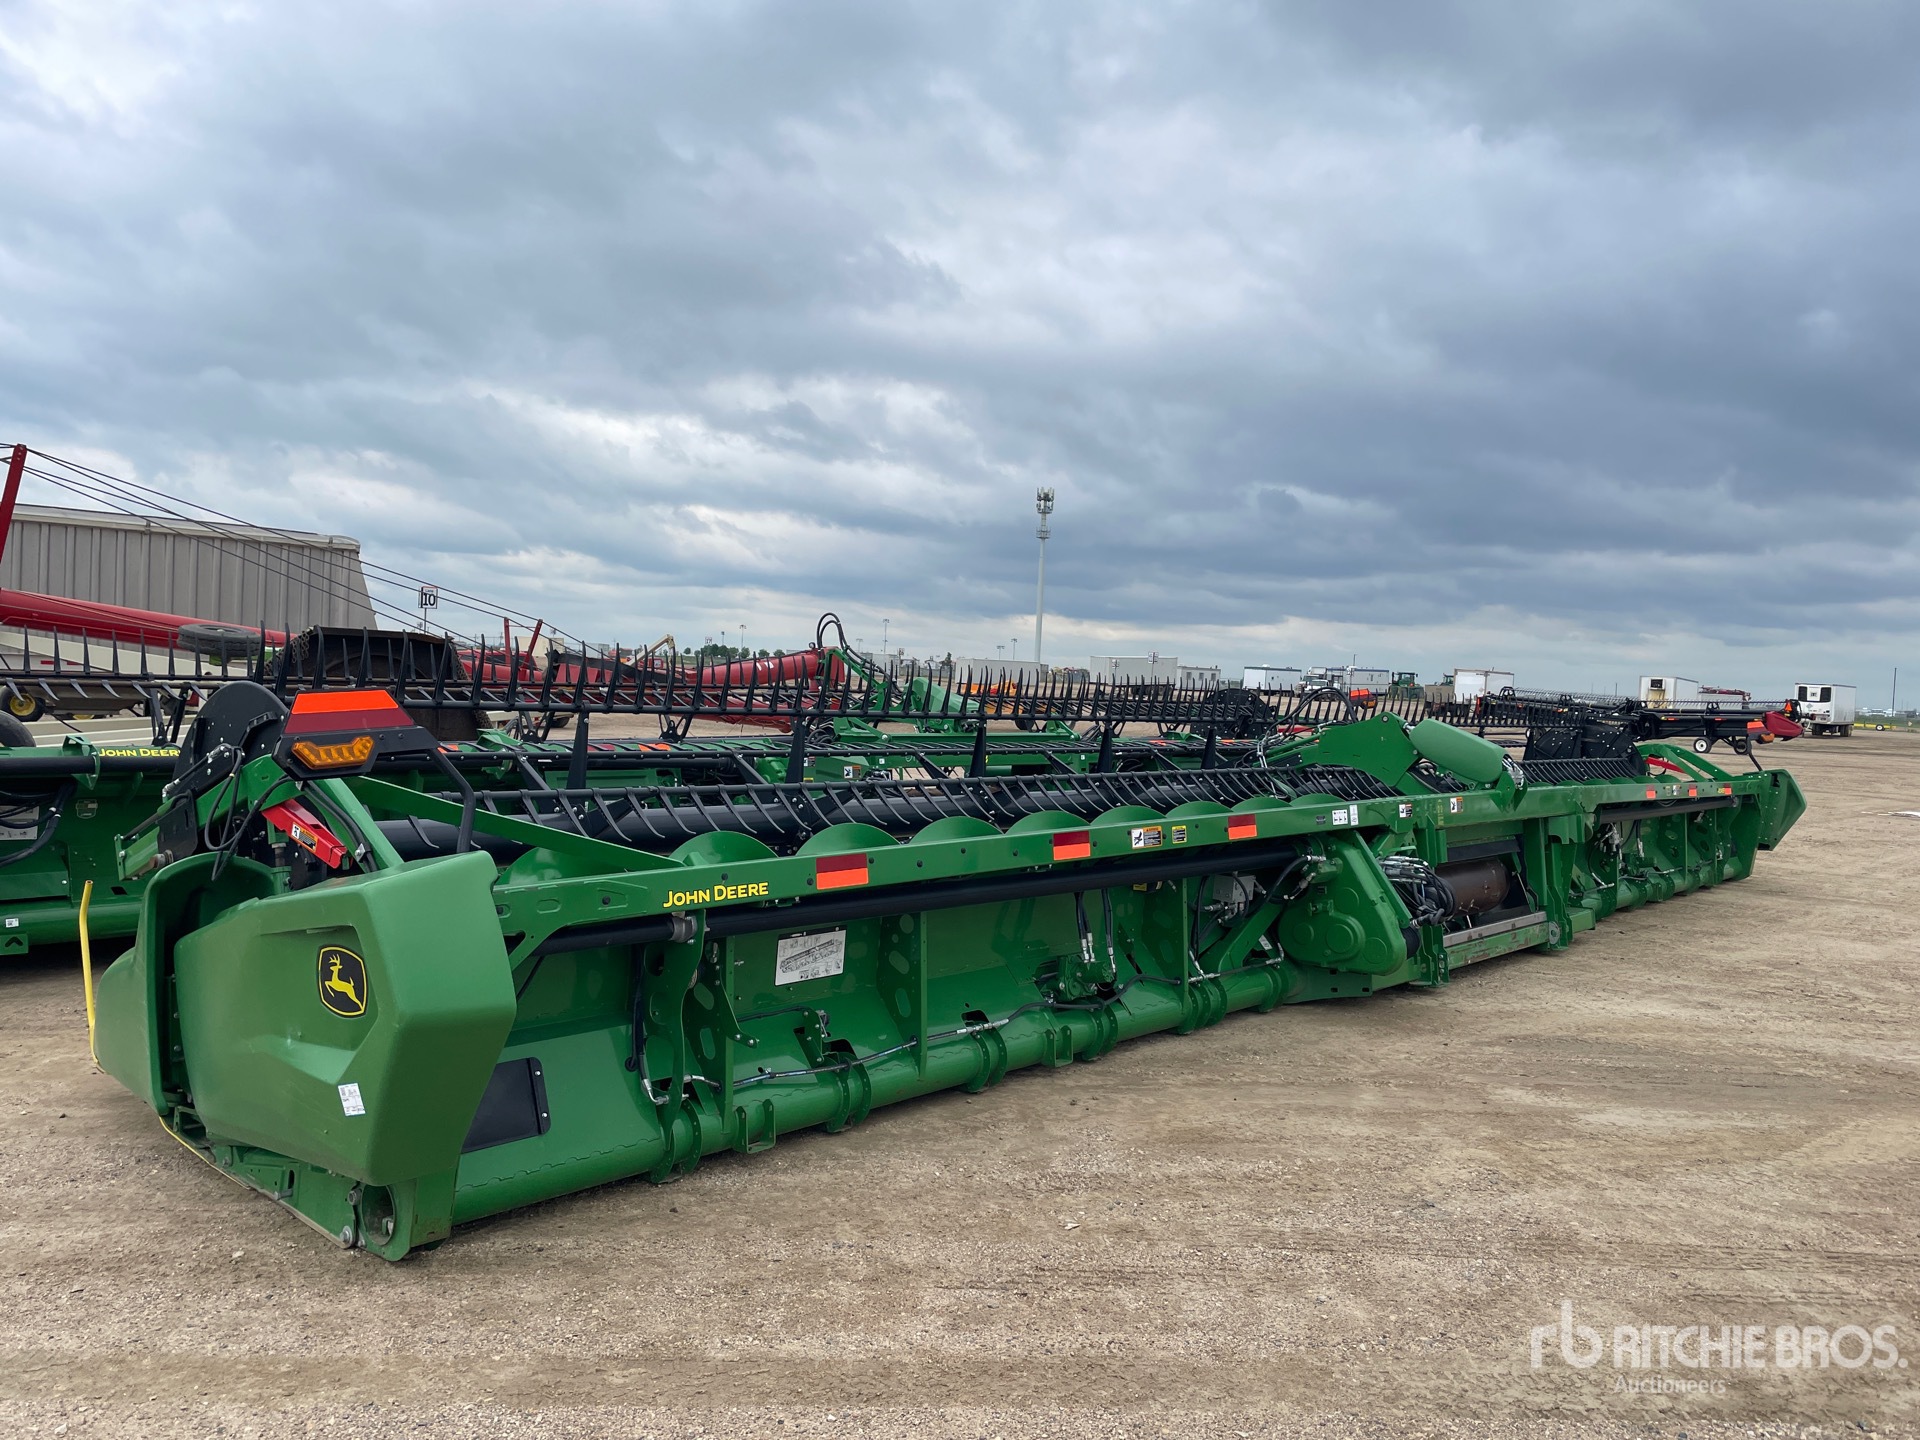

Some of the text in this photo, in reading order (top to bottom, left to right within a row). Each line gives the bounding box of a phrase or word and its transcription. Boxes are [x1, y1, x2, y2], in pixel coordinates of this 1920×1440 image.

[423, 593, 436, 606] 10
[99, 748, 181, 757] JOHN DEER
[663, 882, 769, 908] JOHN DEERE
